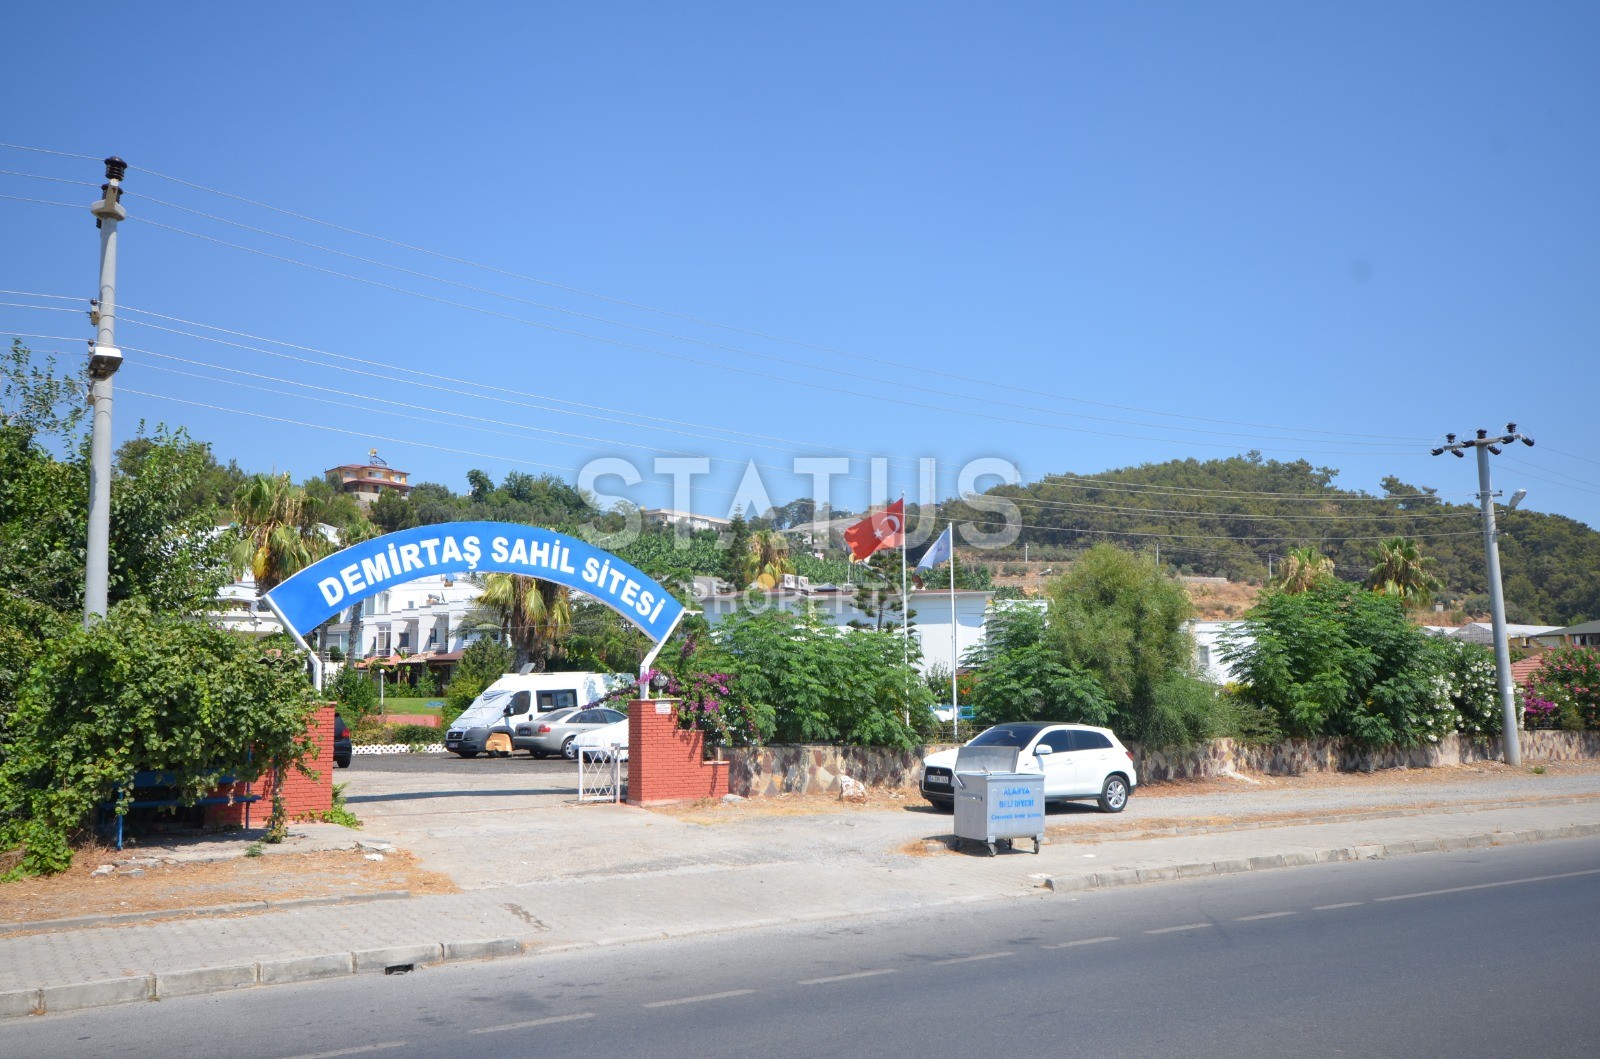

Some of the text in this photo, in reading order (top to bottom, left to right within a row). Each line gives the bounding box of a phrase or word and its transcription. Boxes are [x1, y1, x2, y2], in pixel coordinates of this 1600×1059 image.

[317, 535, 665, 624] DEMİRTAŞ SAHİL SİTESİ
[1003, 788, 1030, 796] ALANYA
